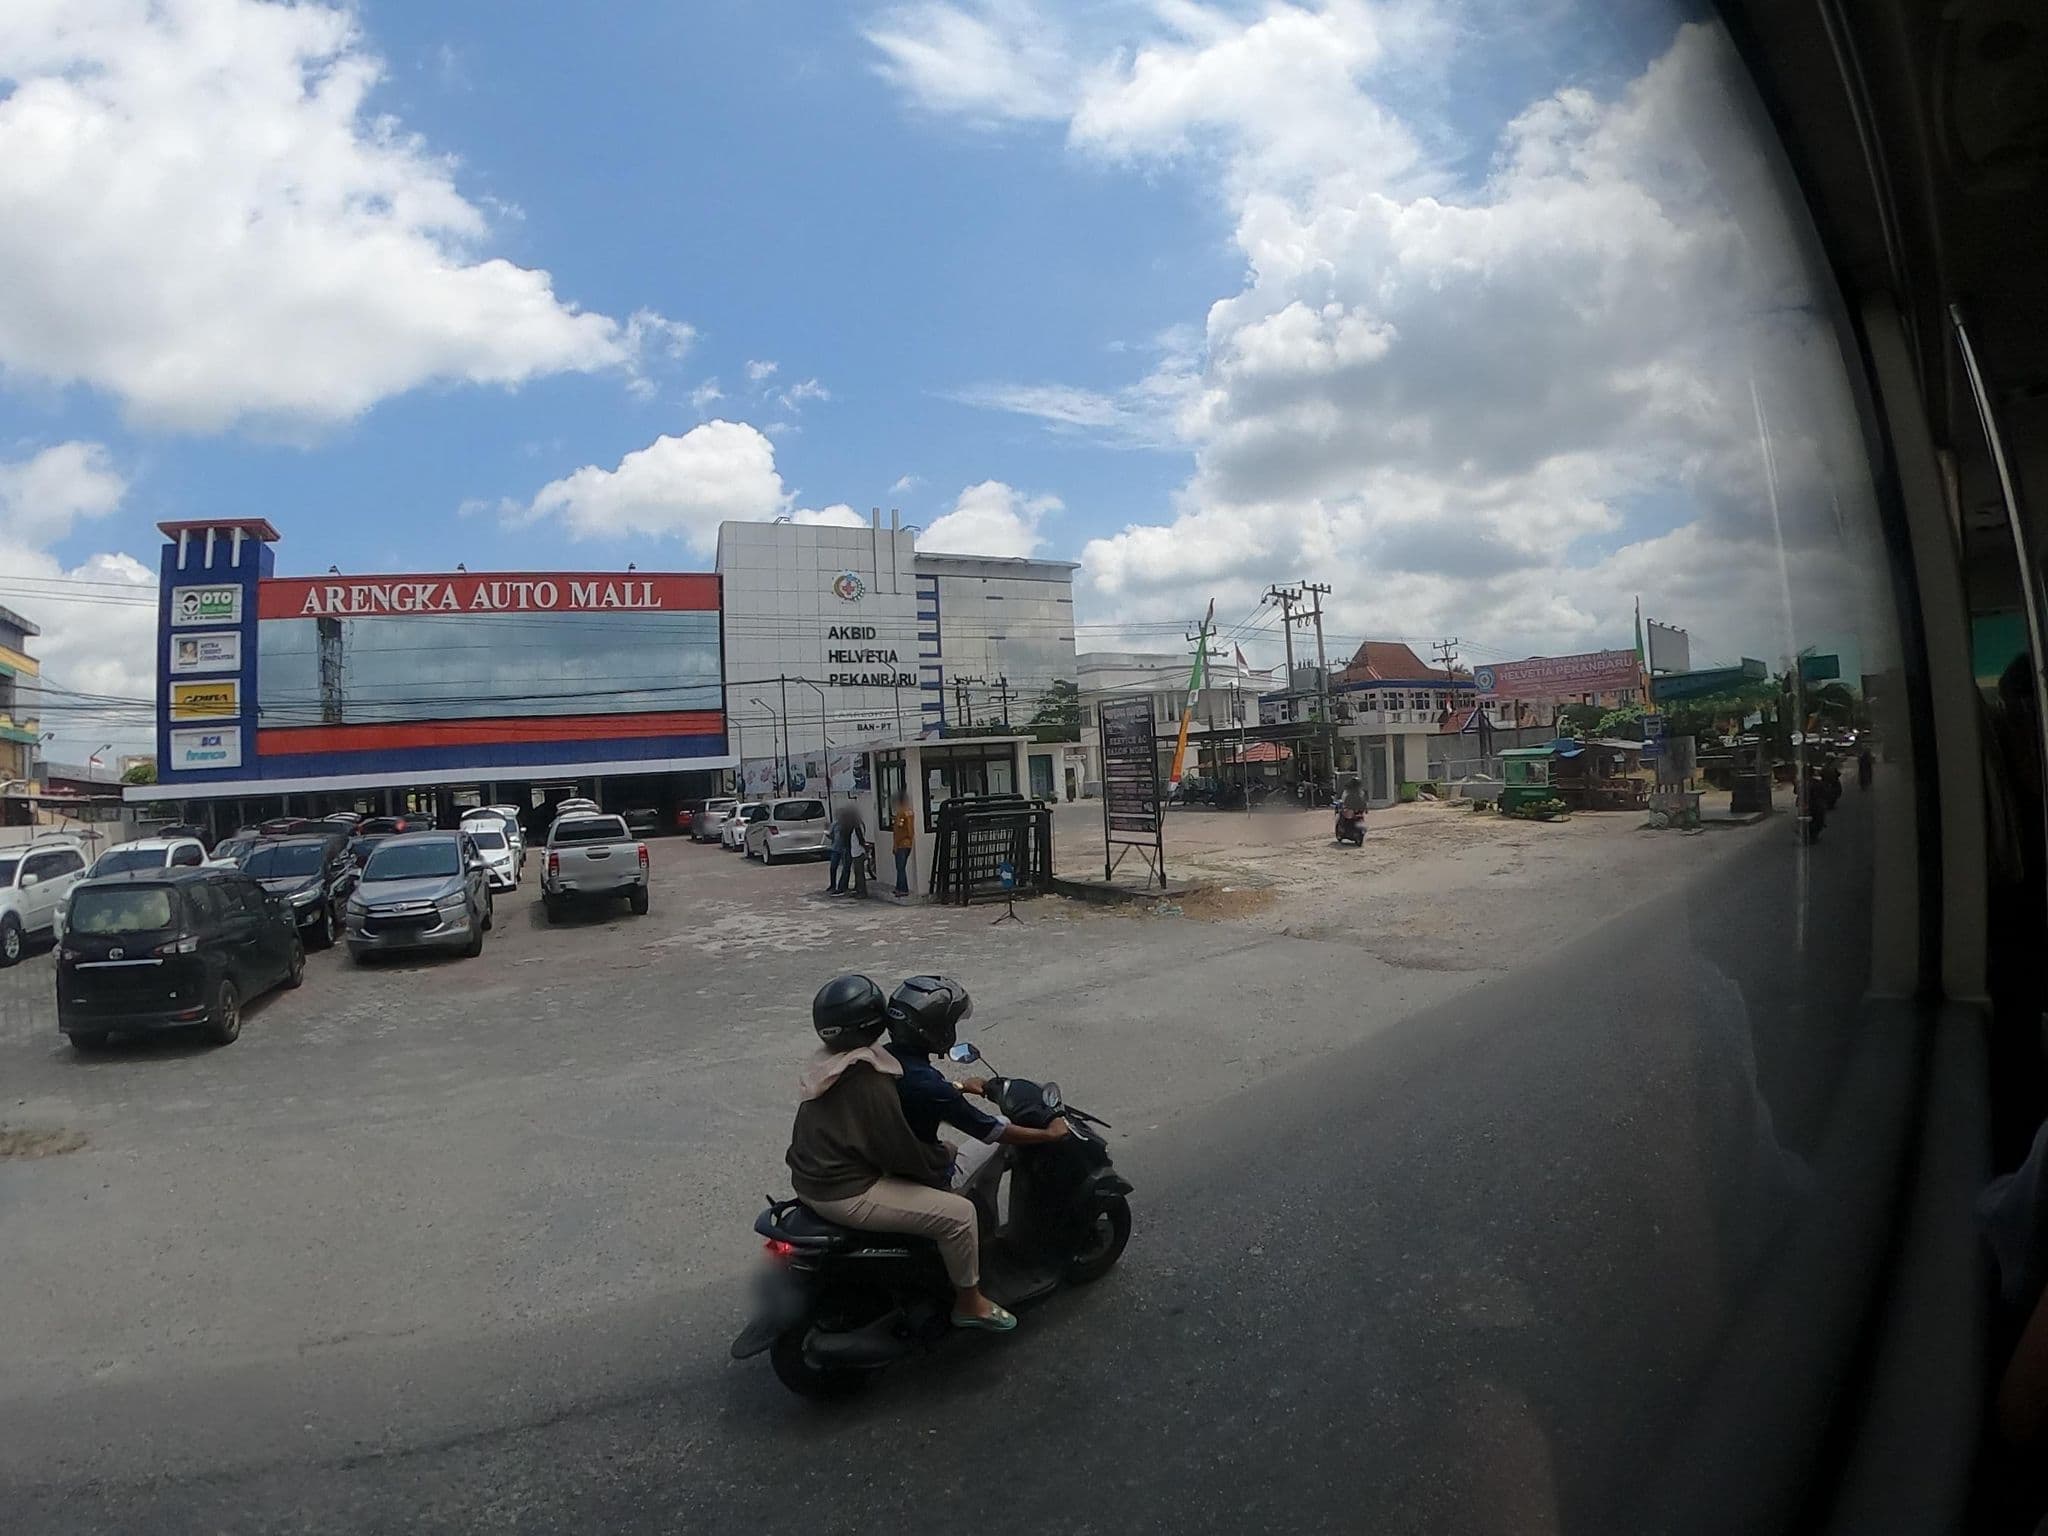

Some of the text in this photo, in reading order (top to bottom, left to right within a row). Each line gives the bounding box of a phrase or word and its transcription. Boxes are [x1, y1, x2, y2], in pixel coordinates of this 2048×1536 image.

[202, 591, 232, 605] OTO
[300, 581, 662, 615] ARENGKA AUTO MALL
[828, 626, 876, 640] AKBID
[828, 649, 898, 664] HELVETIA
[1500, 657, 1633, 681] HELVETIA PEKANBARU
[829, 673, 917, 687] PEKANBARU
